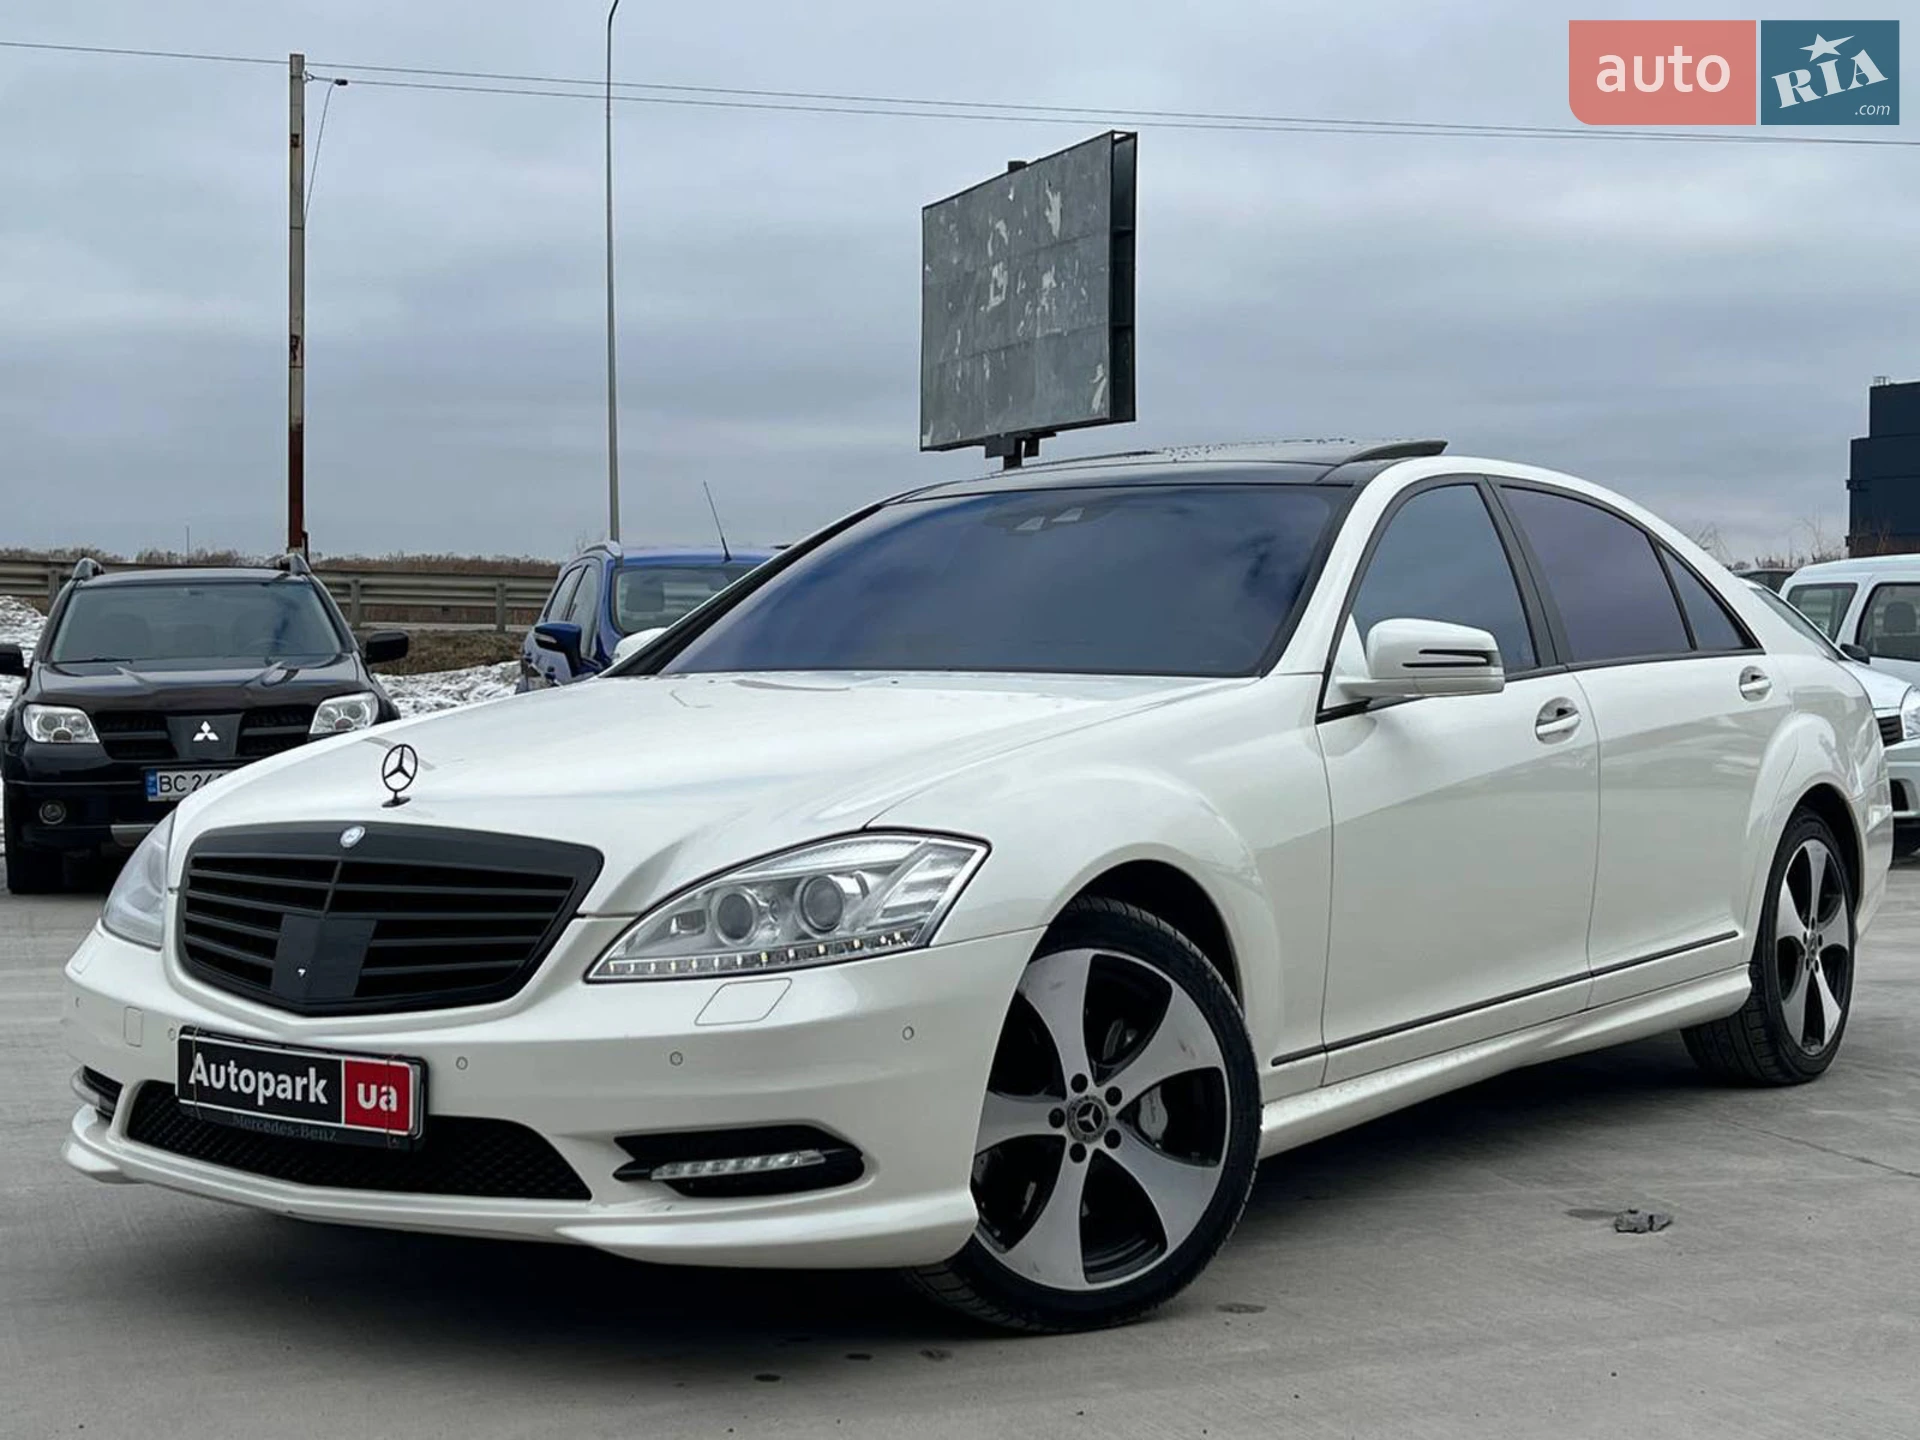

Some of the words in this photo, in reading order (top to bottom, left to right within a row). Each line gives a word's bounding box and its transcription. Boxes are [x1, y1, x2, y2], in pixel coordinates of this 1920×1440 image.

[159, 774, 187, 793] BC
[188, 1052, 328, 1105] Autopark
[357, 1082, 398, 1112] ua
